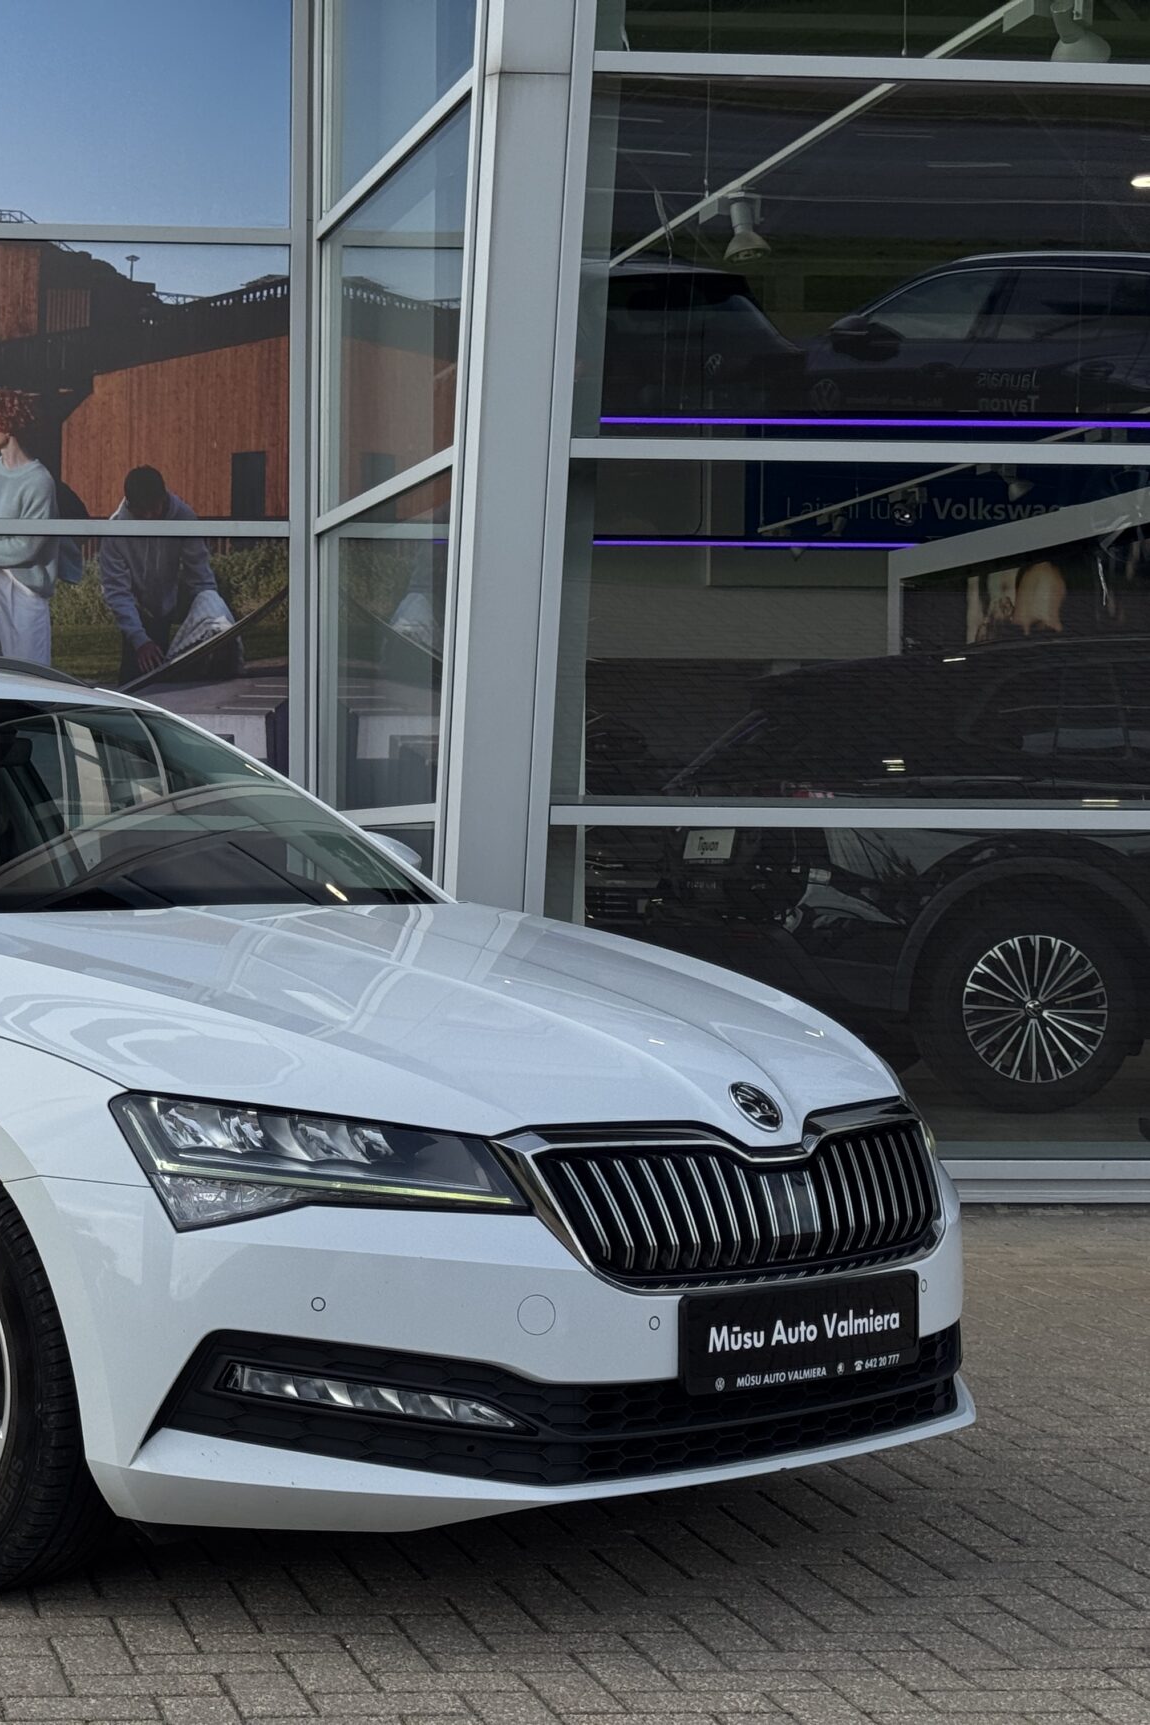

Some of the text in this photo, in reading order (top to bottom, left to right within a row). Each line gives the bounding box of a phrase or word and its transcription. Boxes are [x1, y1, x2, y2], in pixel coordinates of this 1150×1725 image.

[708, 1308, 900, 1353] Mūsu Auto Valmiera
[864, 1353, 900, 1369] 642 20 777
[736, 1366, 827, 1388] MŪSU AUTO VALMIERA
